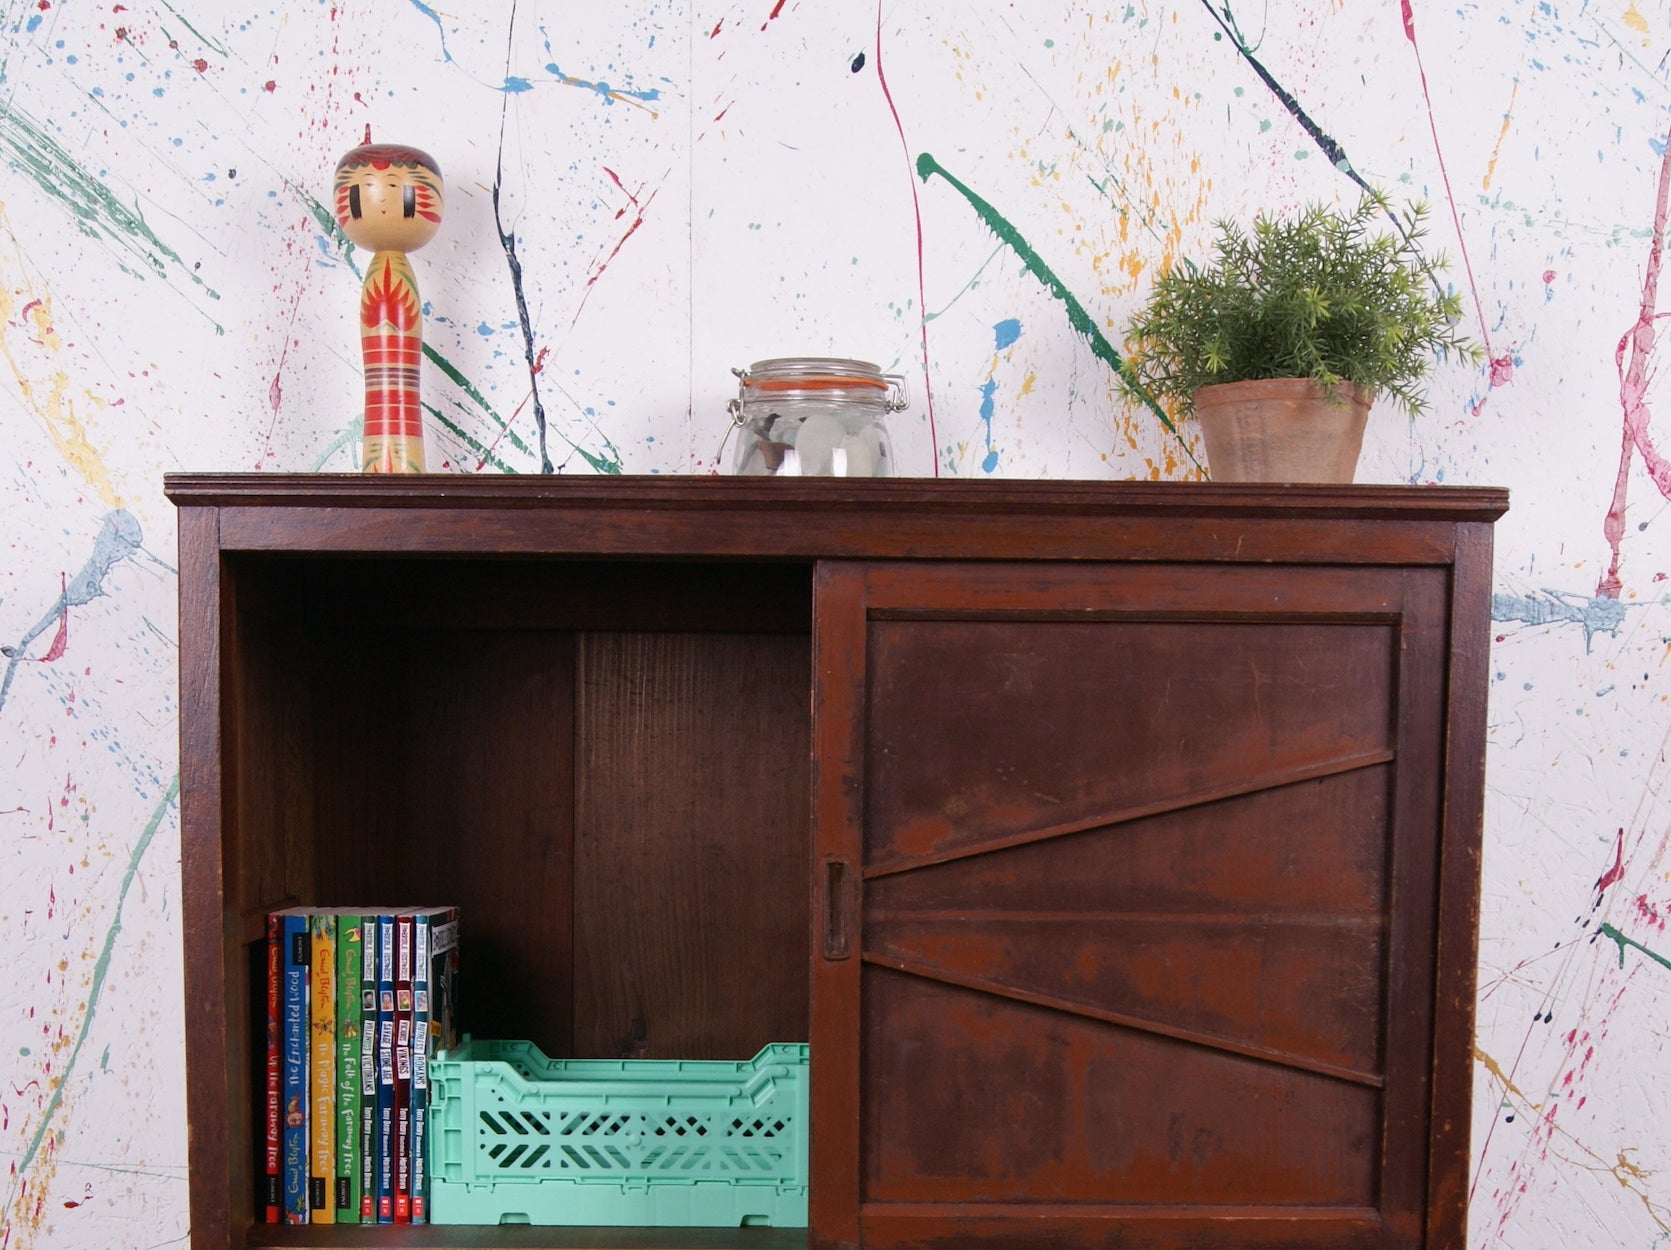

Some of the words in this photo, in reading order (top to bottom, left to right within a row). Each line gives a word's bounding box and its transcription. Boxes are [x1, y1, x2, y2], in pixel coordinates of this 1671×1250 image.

[317, 949, 330, 975] Enid
[342, 949, 356, 975] Enid
[288, 971, 300, 1001] Wood
[317, 977, 330, 1009] Blyton
[344, 977, 357, 1009] Blyton
[287, 1005, 301, 1065] Enchanted
[382, 1023, 392, 1045] SAVAGE
[415, 1023, 426, 1051] RUTHLESS
[344, 1057, 356, 1079] Folk
[382, 1051, 391, 1068] STONE
[399, 1049, 409, 1074] VIKINGS
[415, 1056, 425, 1085] ROMANS
[318, 1059, 331, 1094] Magic
[340, 1080, 353, 1091] of
[363, 1057, 374, 1092] VICTORIANS
[383, 1070, 391, 1080] AGE
[316, 1095, 331, 1146] Faraway
[341, 1109, 354, 1149] Faraway
[288, 1132, 300, 1165] Blyton
[318, 1149, 330, 1173] Tree
[343, 1152, 354, 1176] Tree
[287, 1166, 302, 1194] Enid
